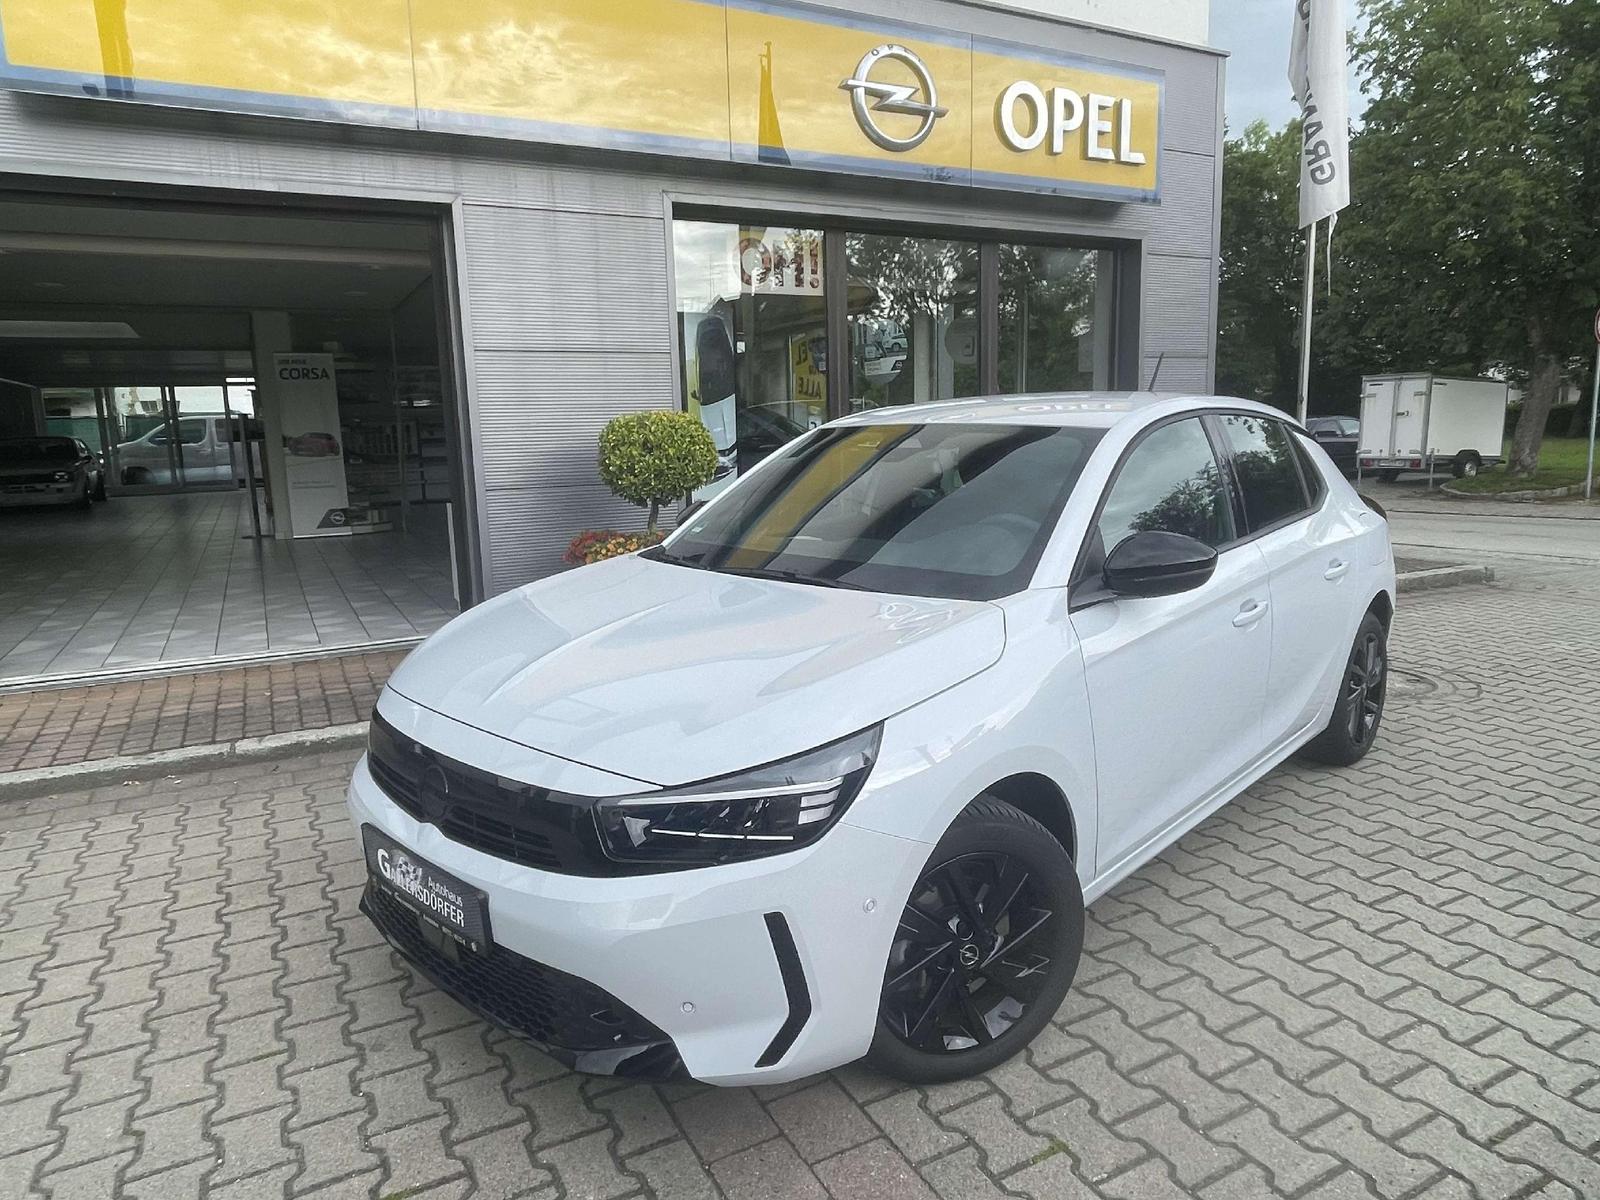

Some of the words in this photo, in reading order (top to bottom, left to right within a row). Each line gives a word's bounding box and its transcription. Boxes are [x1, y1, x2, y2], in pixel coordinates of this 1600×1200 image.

[998, 80, 1146, 165] OPEL
[279, 367, 330, 380] CORSA
[428, 876, 463, 907] Autohaus
